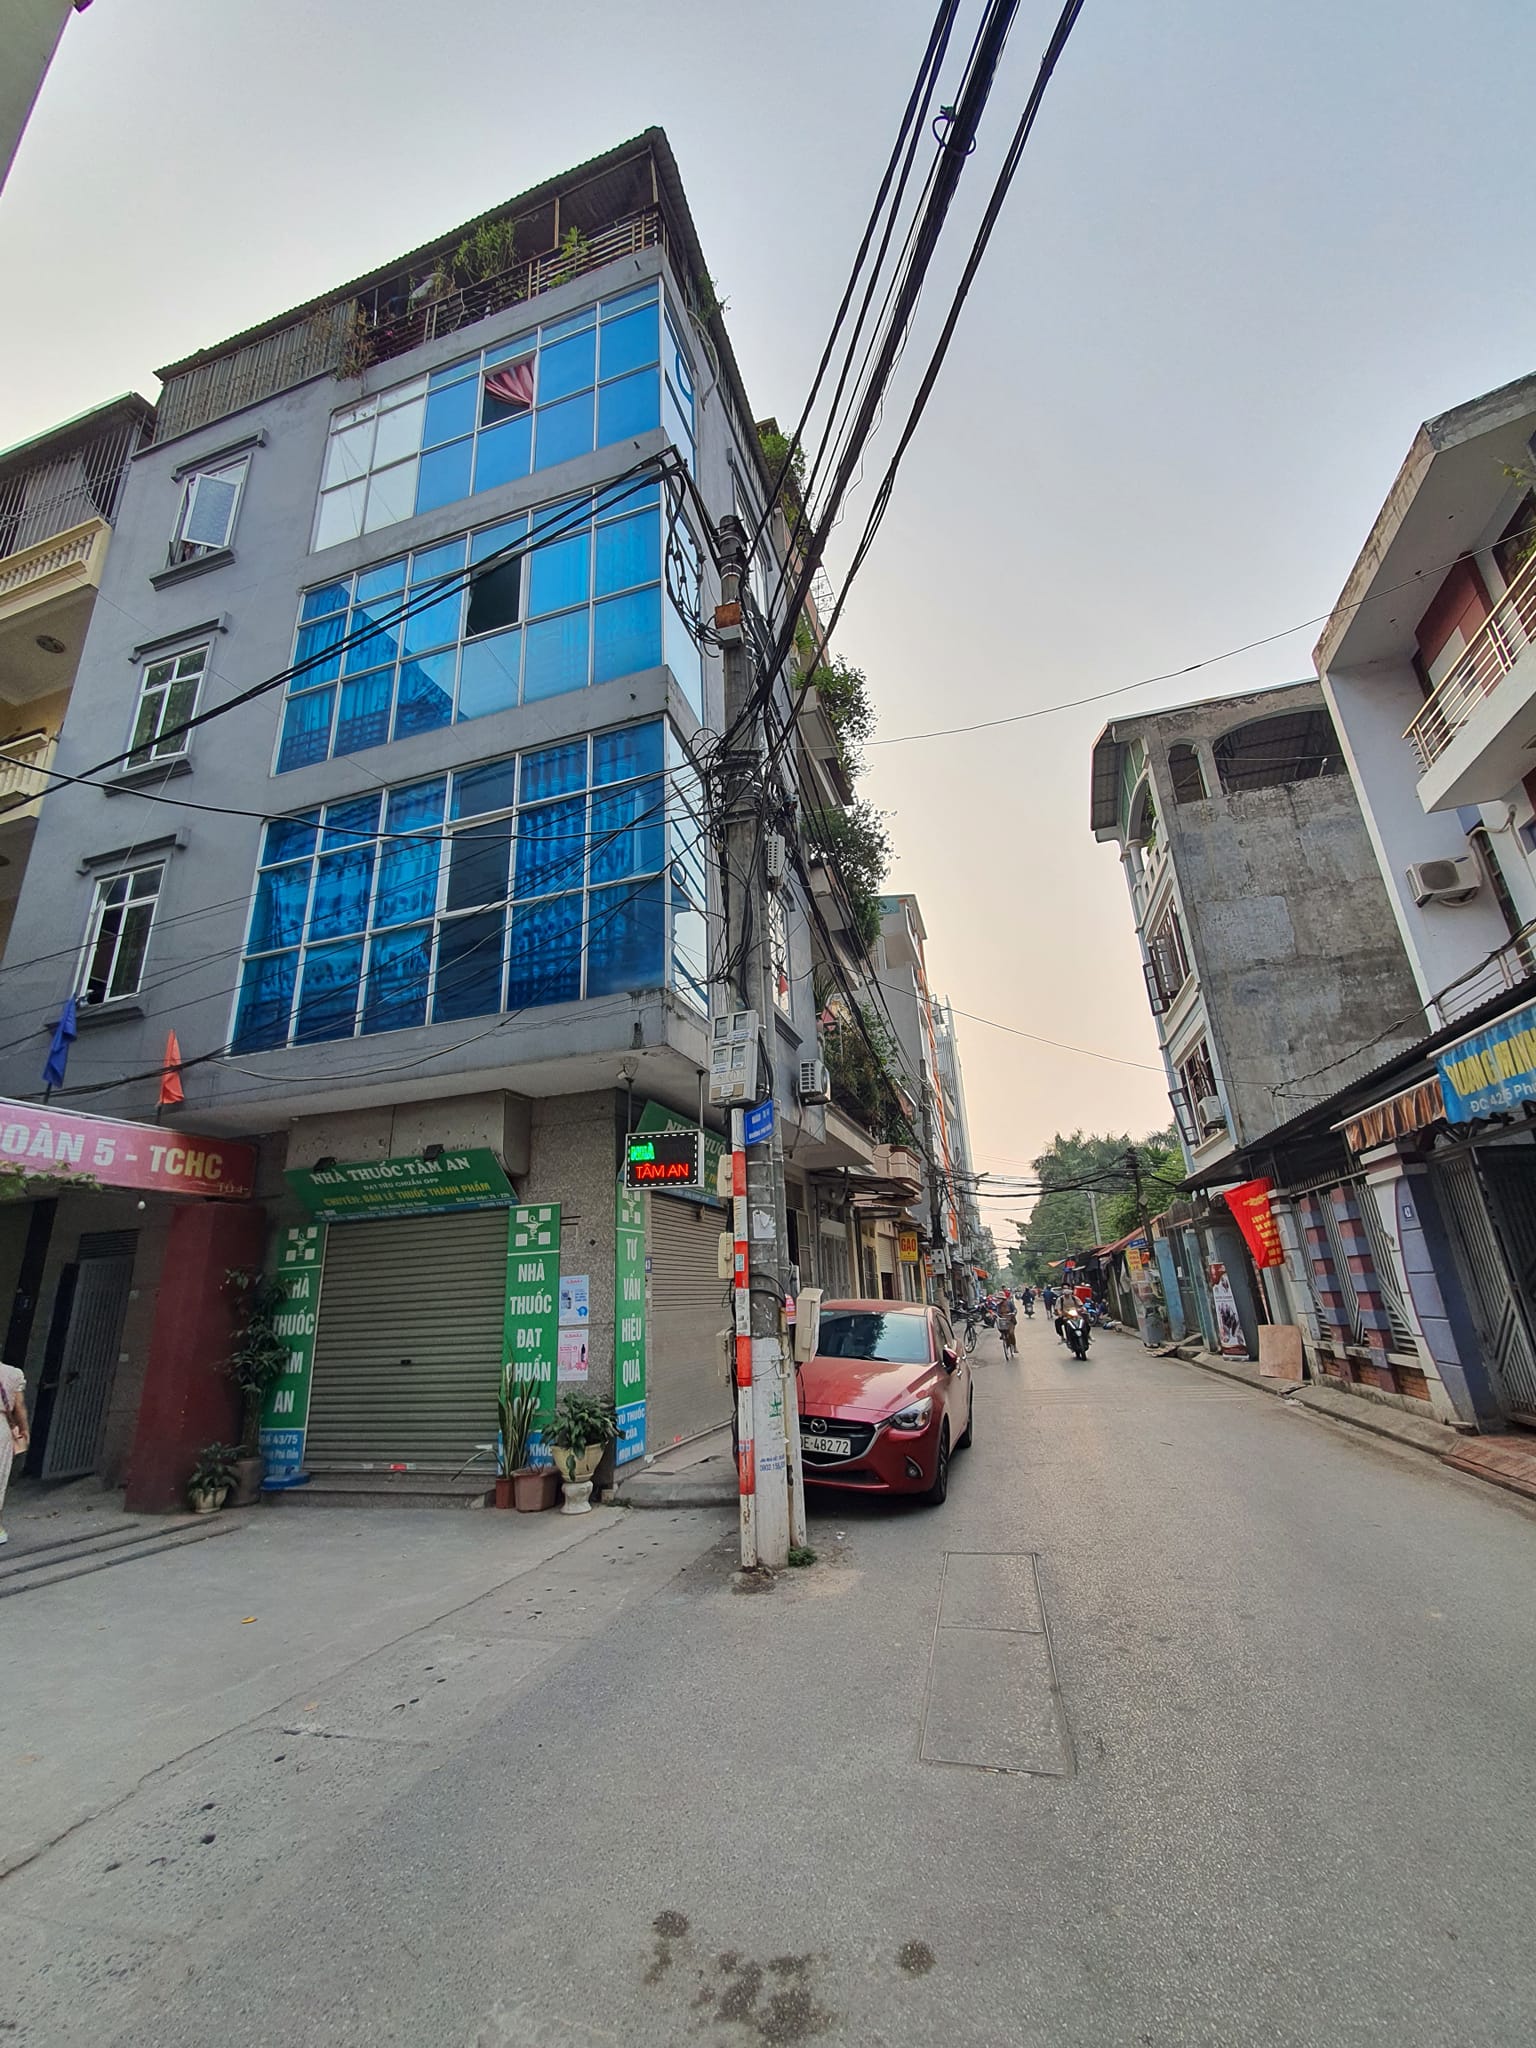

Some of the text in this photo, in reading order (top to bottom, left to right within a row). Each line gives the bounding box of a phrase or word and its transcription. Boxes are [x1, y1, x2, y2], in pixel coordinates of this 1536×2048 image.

[0, 1121, 224, 1180] OÀN 5 - TCHC
[309, 1157, 471, 1186] NHÀ THUỐC TÂM AN
[635, 1163, 665, 1180] TÂM
[667, 1163, 690, 1179] AN
[625, 1238, 638, 1261] TƯ
[517, 1258, 546, 1283] NHÀ
[623, 1270, 641, 1301] VẤN
[510, 1288, 552, 1315] THUỐC
[516, 1328, 543, 1352] ĐẠT
[621, 1313, 642, 1347] HIỆU
[622, 1351, 641, 1386] QUẢ
[273, 1390, 295, 1413] AN
